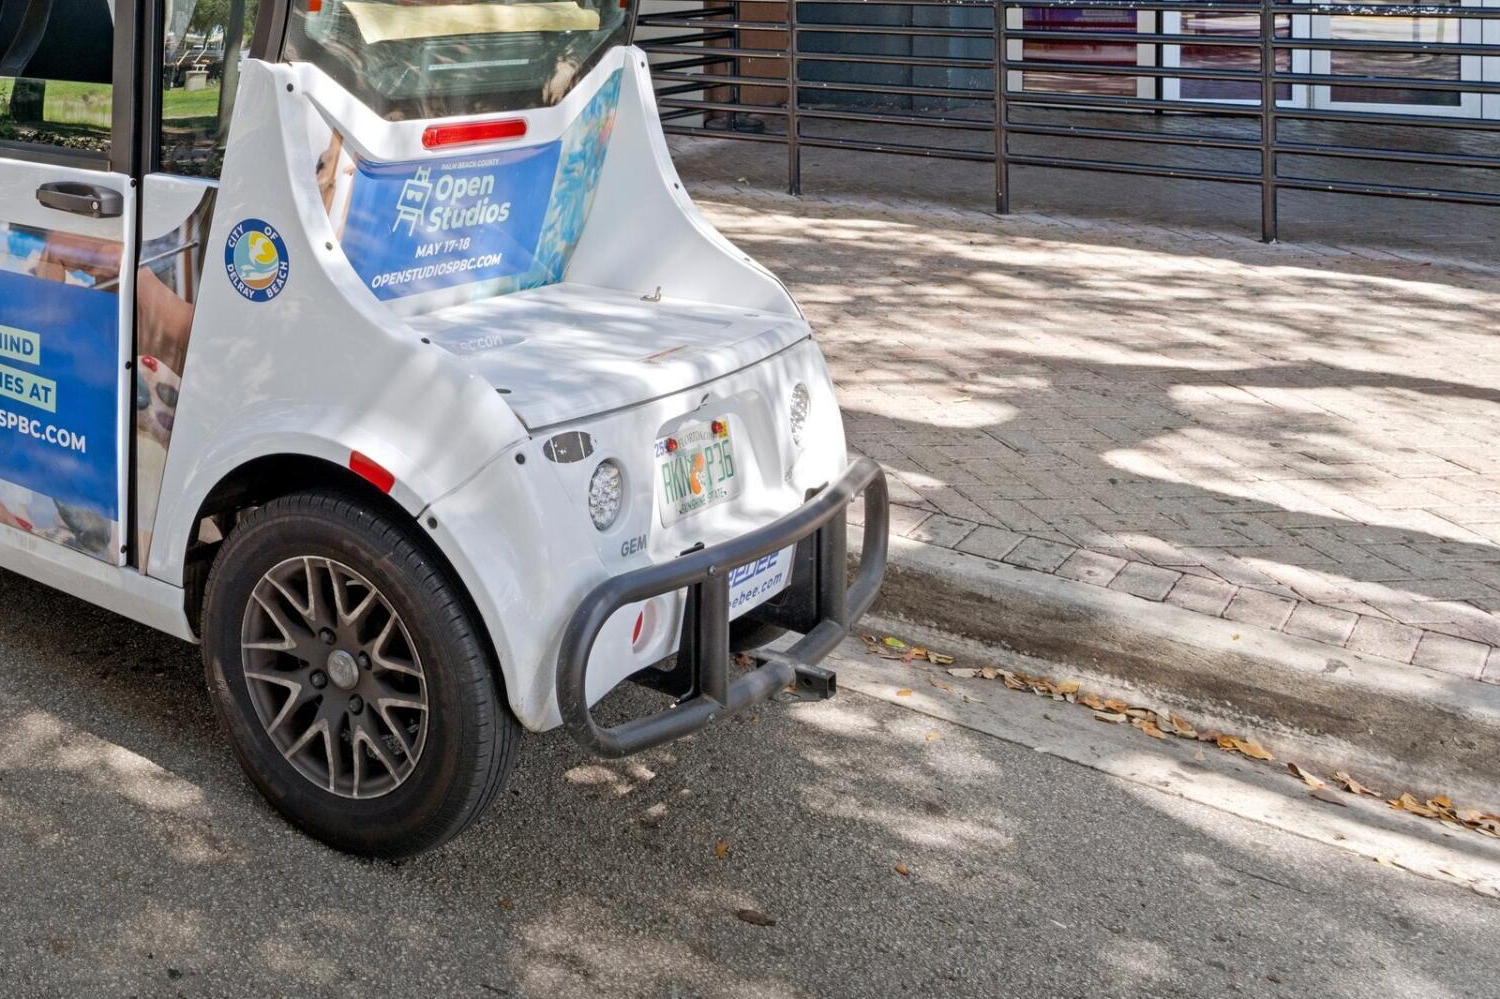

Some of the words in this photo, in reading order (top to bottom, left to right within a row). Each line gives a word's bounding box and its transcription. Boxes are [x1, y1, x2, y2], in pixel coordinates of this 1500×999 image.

[458, 160, 476, 169] BEACH
[476, 158, 501, 168] COUNTY
[435, 174, 495, 206] Open
[426, 197, 512, 233] Studios
[228, 224, 244, 248] CITY
[264, 226, 279, 241] OF
[415, 241, 444, 259] MAY
[443, 237, 472, 254] 17-18
[227, 263, 256, 299] DELRAY
[265, 261, 288, 298] BEACH
[371, 253, 504, 289] OPENSTUDIOSPBC.COM
[29, 383, 52, 404] AT
[621, 534, 647, 558] GEM
